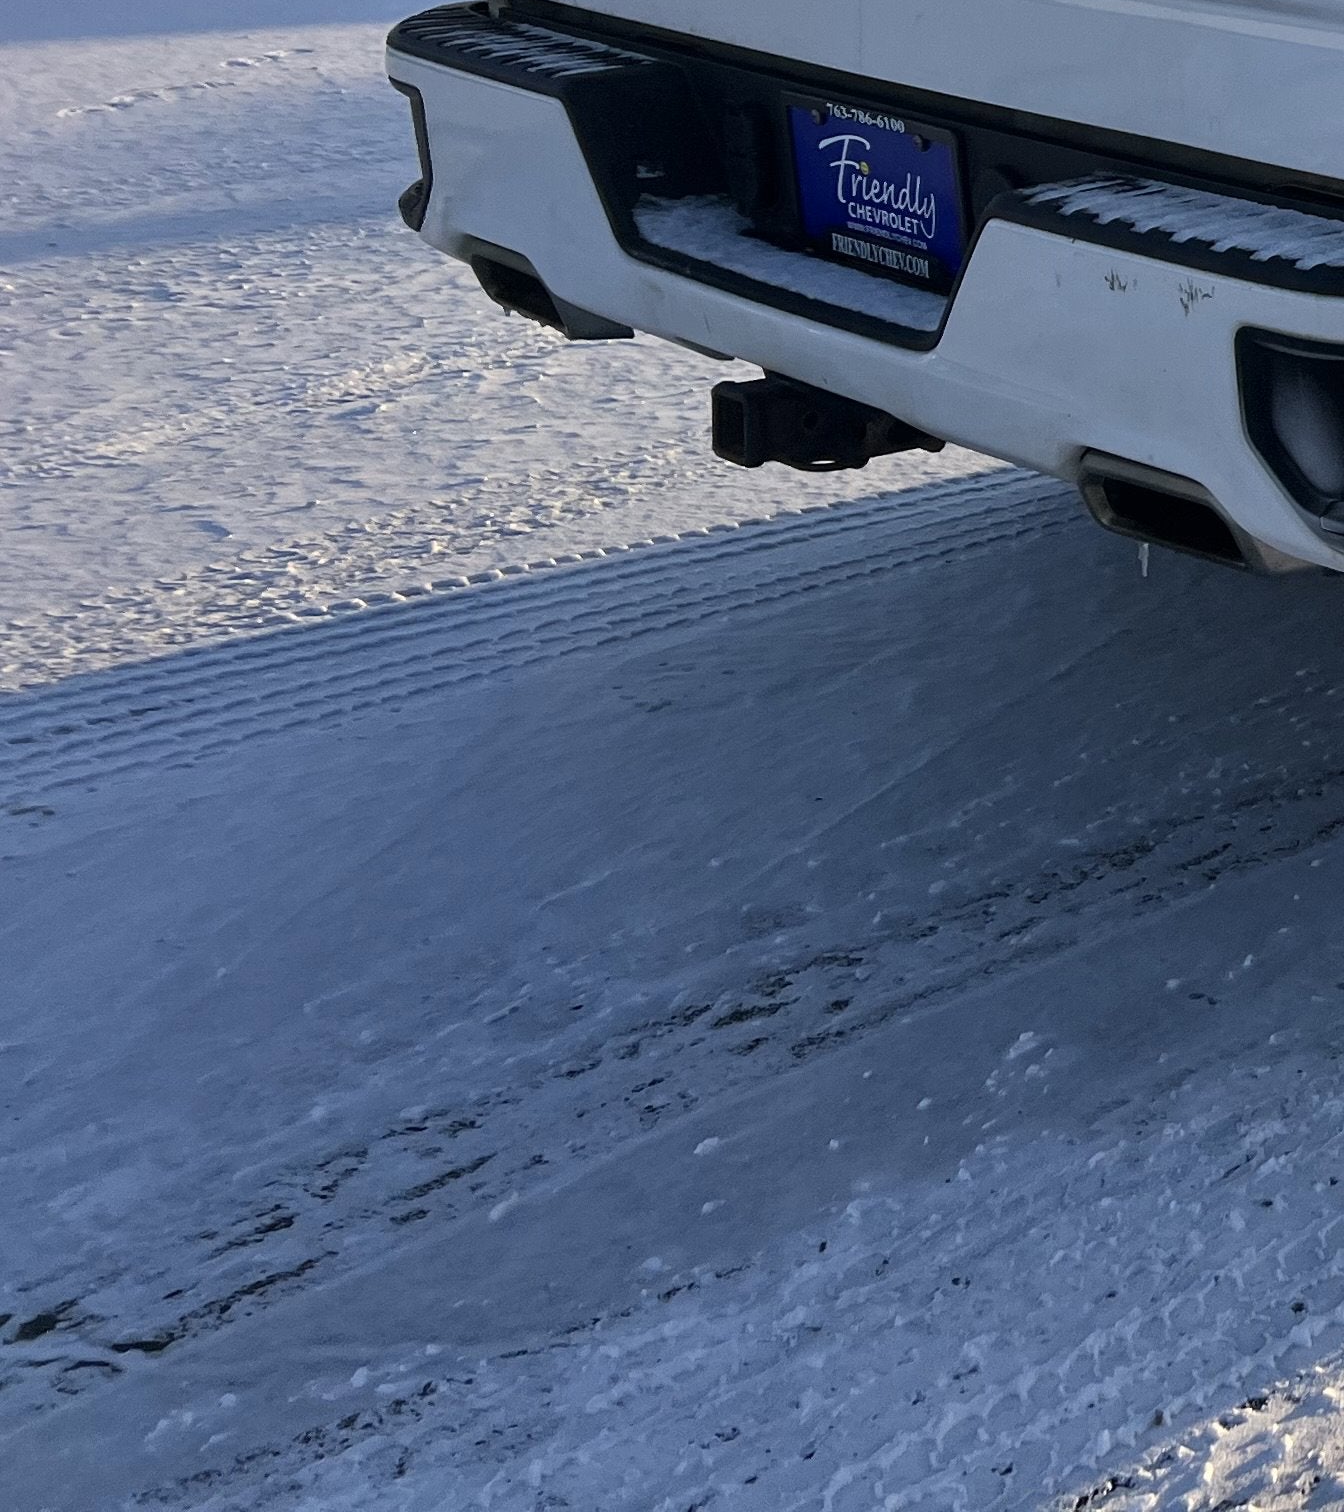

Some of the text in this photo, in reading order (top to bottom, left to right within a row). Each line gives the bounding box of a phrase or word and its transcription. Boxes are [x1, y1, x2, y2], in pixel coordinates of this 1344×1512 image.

[826, 102, 906, 134] 763-786-6100
[818, 134, 936, 239] Friendly
[848, 201, 919, 236] CHEVROLET
[831, 232, 930, 279] FRIENDLYCHEV.COM
